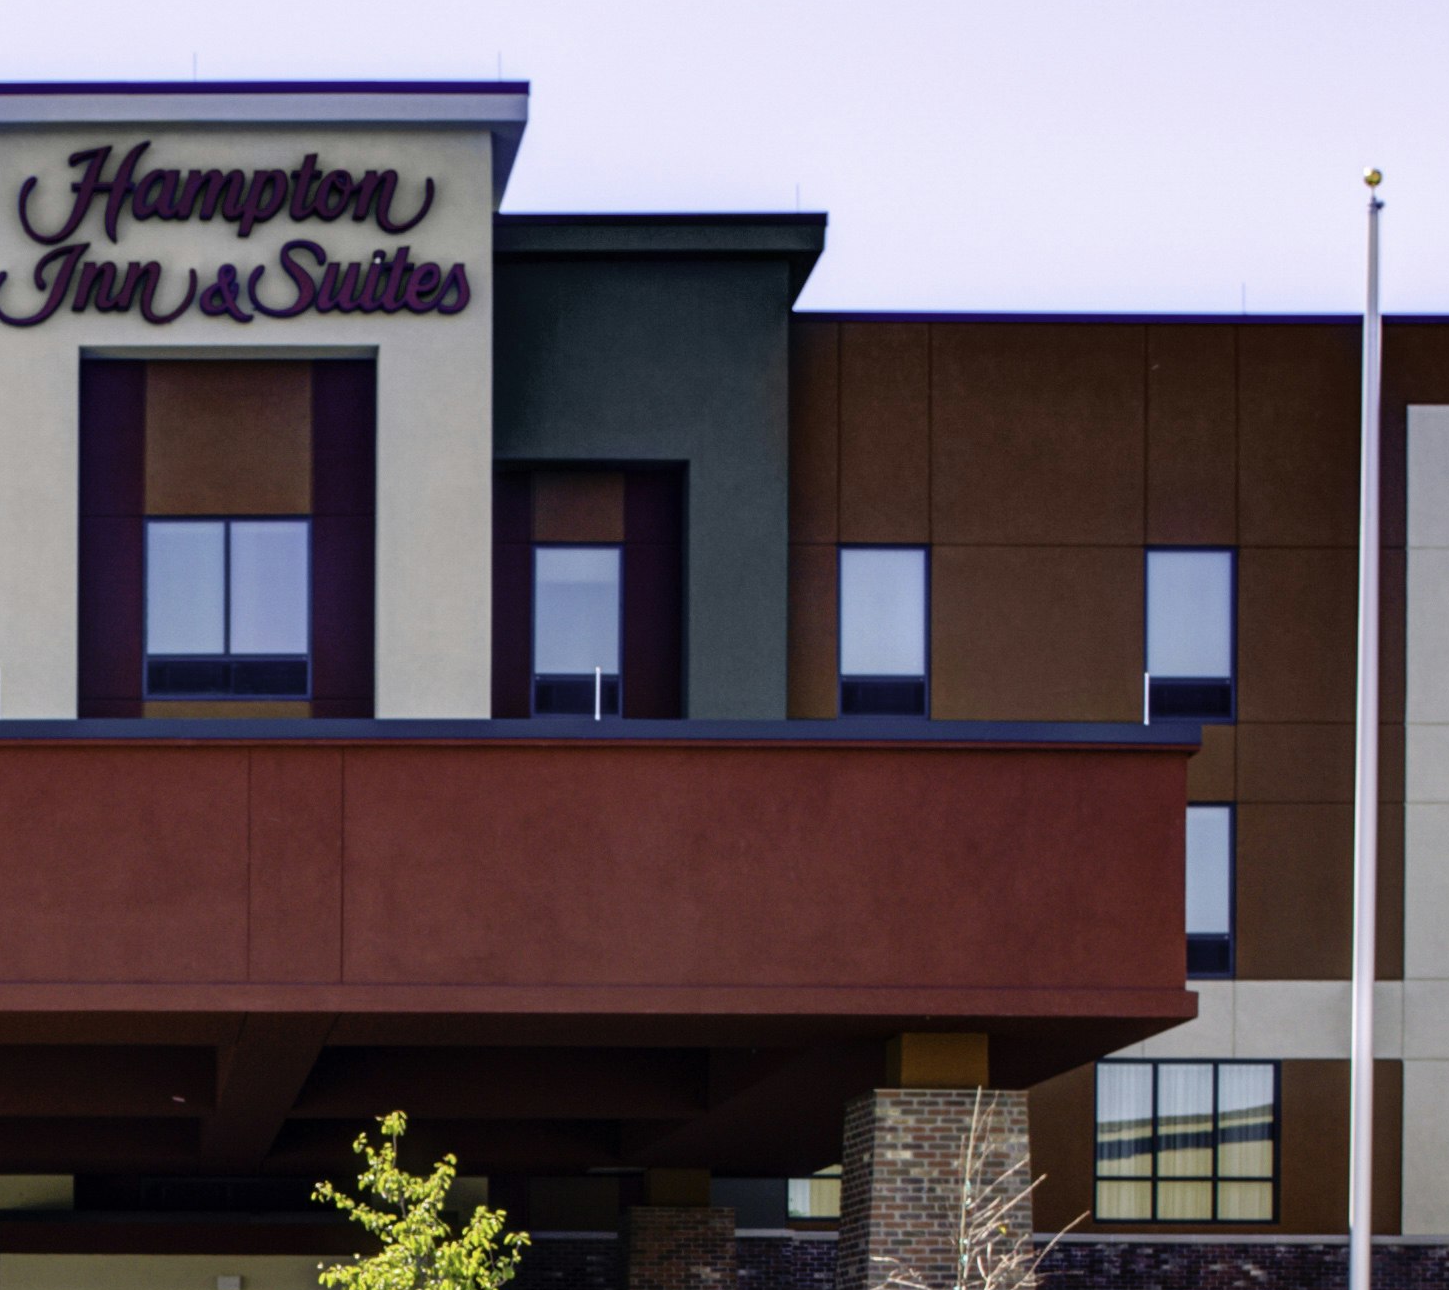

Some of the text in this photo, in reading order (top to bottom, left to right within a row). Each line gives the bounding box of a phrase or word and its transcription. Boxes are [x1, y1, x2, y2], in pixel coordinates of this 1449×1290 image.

[18, 141, 435, 245] Hampton
[199, 263, 254, 324] &
[248, 239, 471, 318] Suites
